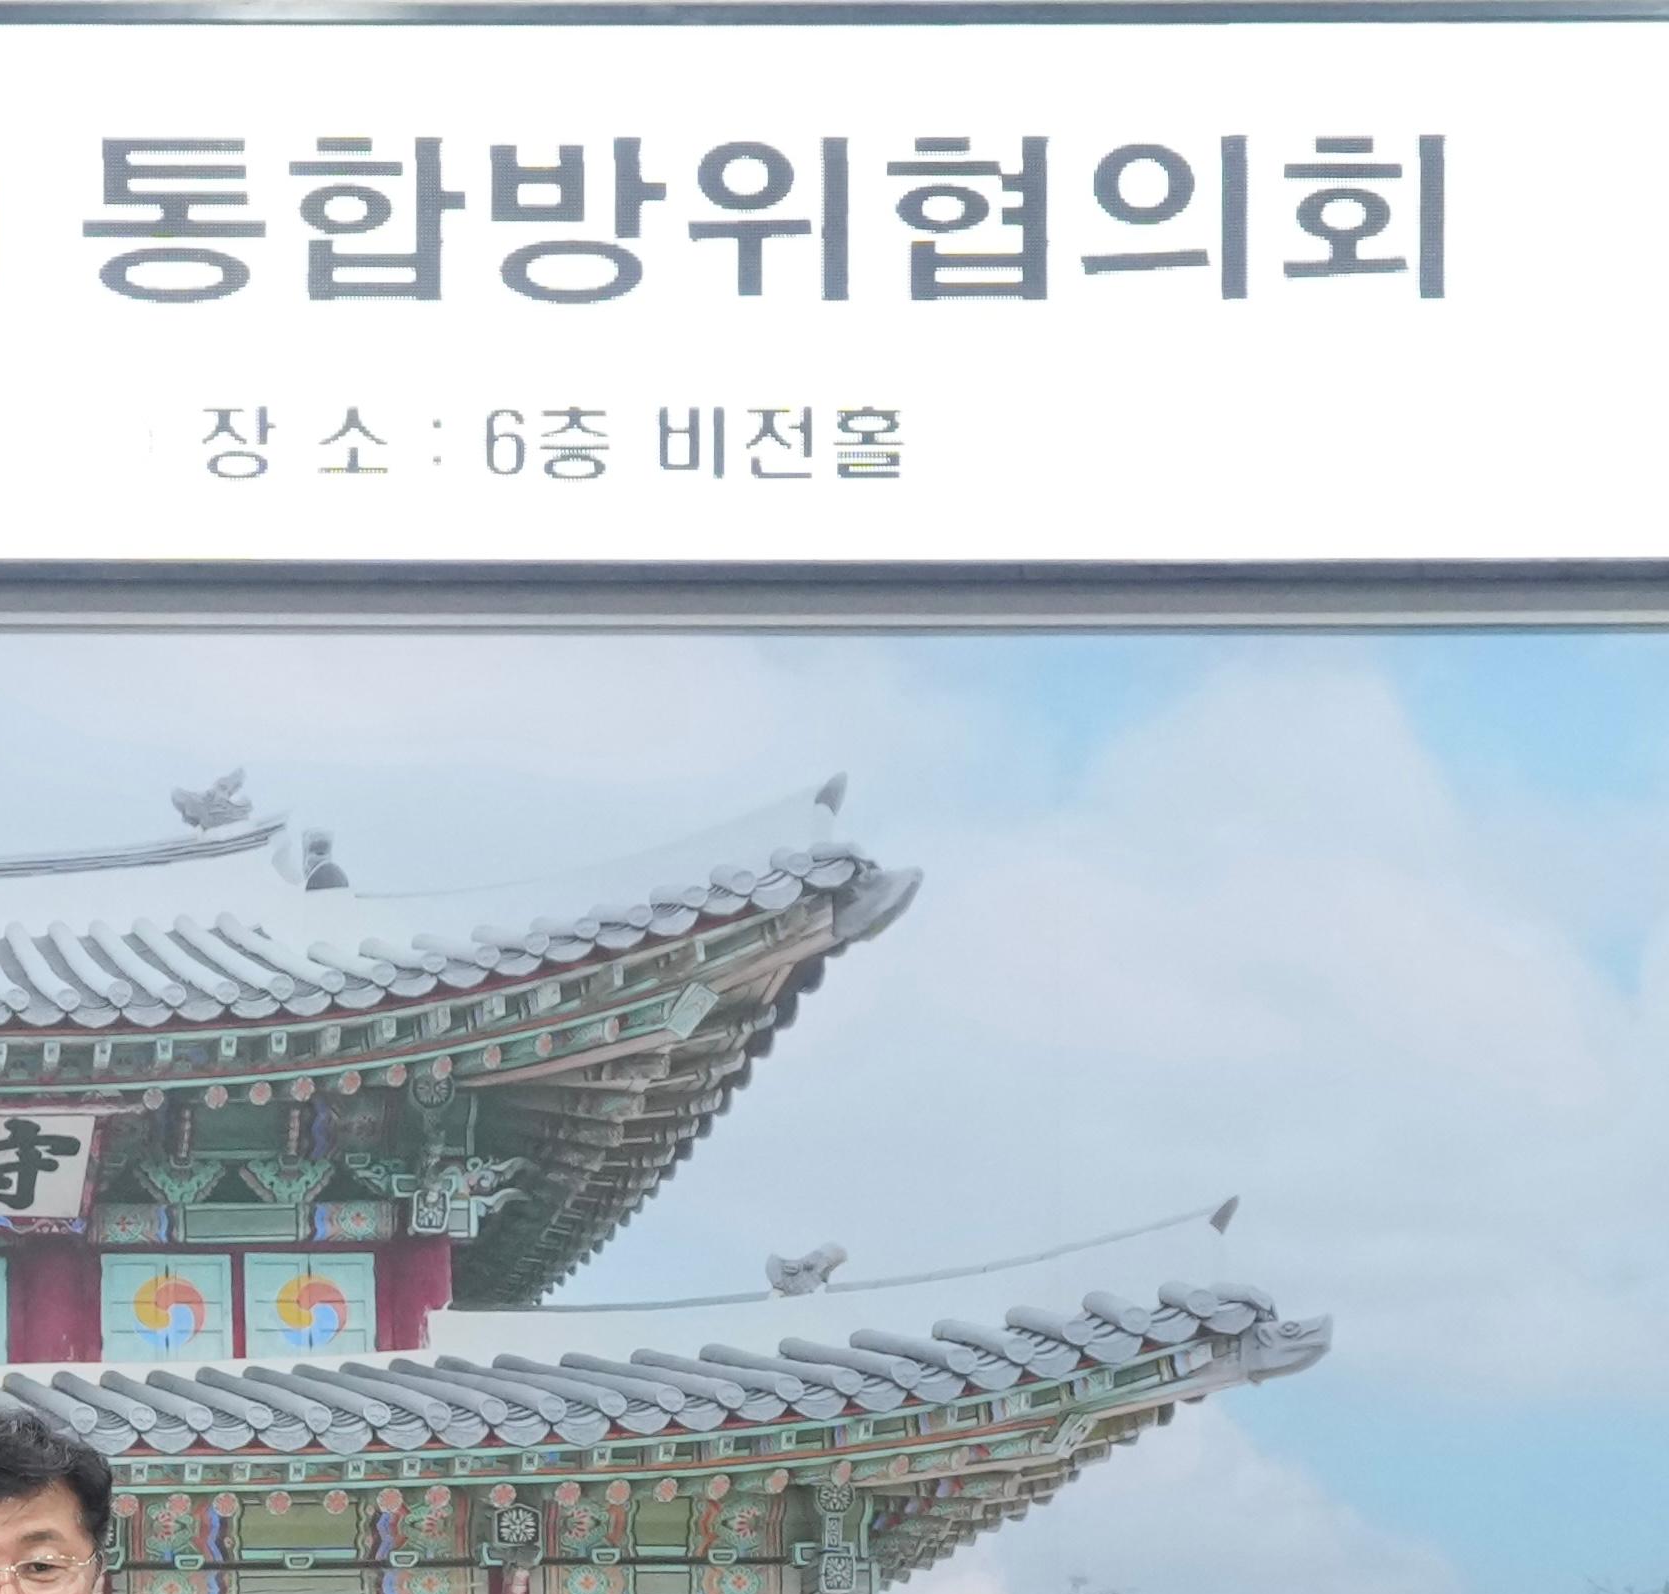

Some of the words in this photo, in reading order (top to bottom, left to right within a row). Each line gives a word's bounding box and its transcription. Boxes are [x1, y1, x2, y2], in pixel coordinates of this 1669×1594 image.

[82, 134, 1446, 305] 통합방위협의회
[485, 406, 610, 481] 6층
[658, 405, 905, 480] 비전홀
